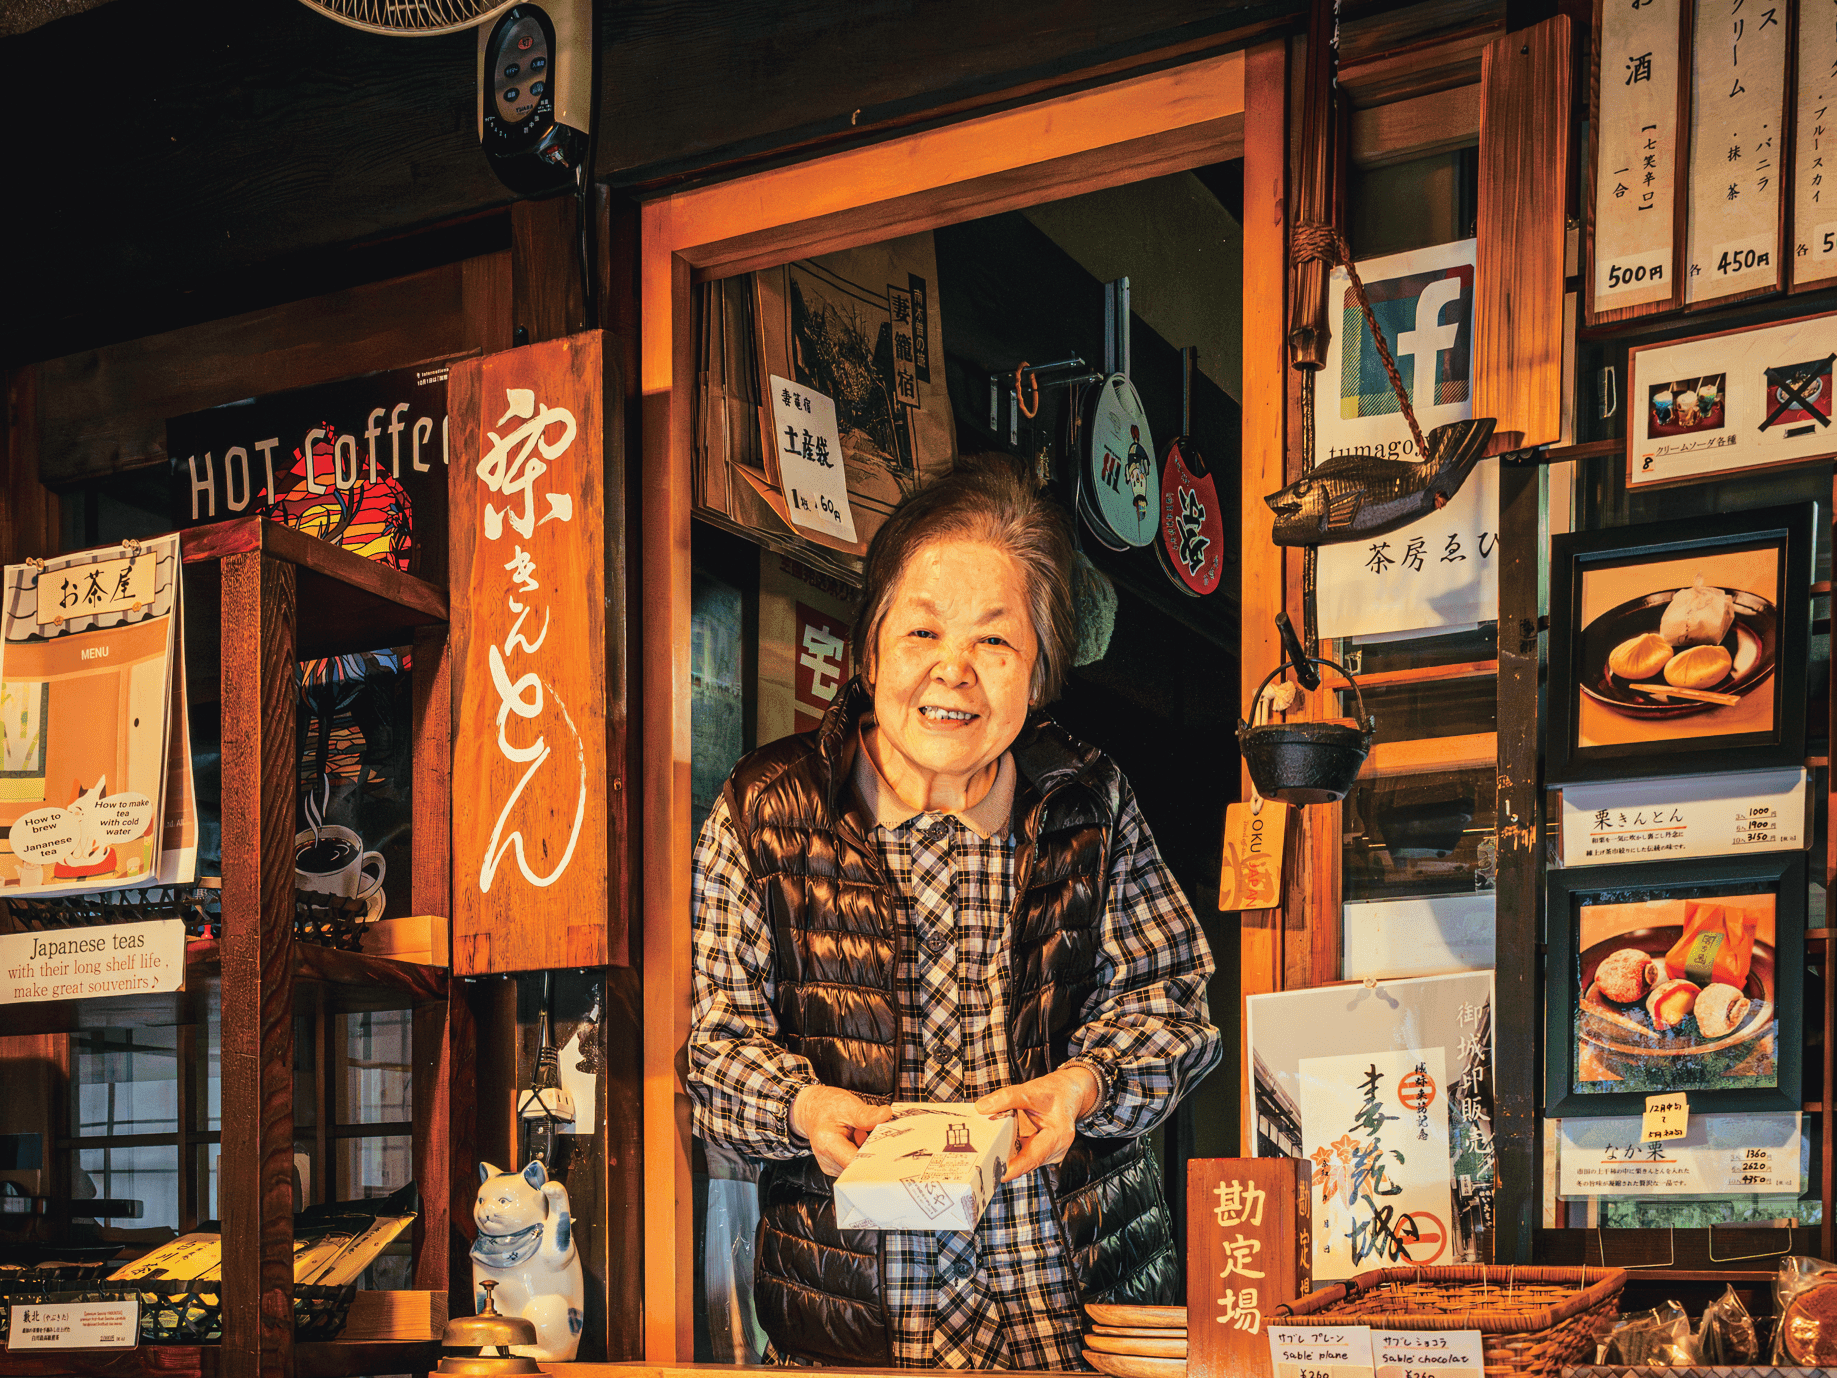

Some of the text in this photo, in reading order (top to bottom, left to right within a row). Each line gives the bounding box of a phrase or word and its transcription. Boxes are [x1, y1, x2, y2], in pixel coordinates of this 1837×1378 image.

[1612, 167, 1629, 199] 一合
[1717, 249, 1769, 275] 450円
[1608, 265, 1663, 288] 500円
[892, 294, 916, 400] 妻籠宿
[1397, 276, 1461, 405] f
[784, 425, 834, 469] 土産袋
[1655, 434, 1737, 457] クリームソーダ各種
[1643, 456, 1653, 470] 8
[189, 437, 279, 520] HOT
[58, 565, 136, 608] お茶屋
[81, 646, 109, 660] MENU
[800, 623, 844, 701] 宅
[129, 799, 149, 808] make
[25, 817, 48, 826] How
[32, 822, 57, 833] brew
[122, 817, 139, 826] cold
[1593, 808, 1684, 830] 栗きんとん
[106, 828, 131, 836] water
[1250, 819, 1264, 853] OKU
[40, 848, 57, 857] tea
[1246, 862, 1259, 908] JAPAN
[30, 933, 145, 960] Japanese teas
[8, 964, 34, 979] with
[40, 961, 69, 977] their
[74, 959, 101, 976] long
[106, 954, 136, 972] shelf
[14, 974, 149, 998] make great souvenirs
[1457, 1002, 1492, 1155] 御城印販売
[1604, 1142, 1666, 1161] なか栗
[1213, 1179, 1265, 1335] 勘定場
[1279, 1332, 1344, 1343] サブレ プレーン
[1383, 1337, 1447, 1348] サブレ ショコラ
[1319, 1350, 1348, 1361] plane
[1418, 1353, 1469, 1364] chocolat
